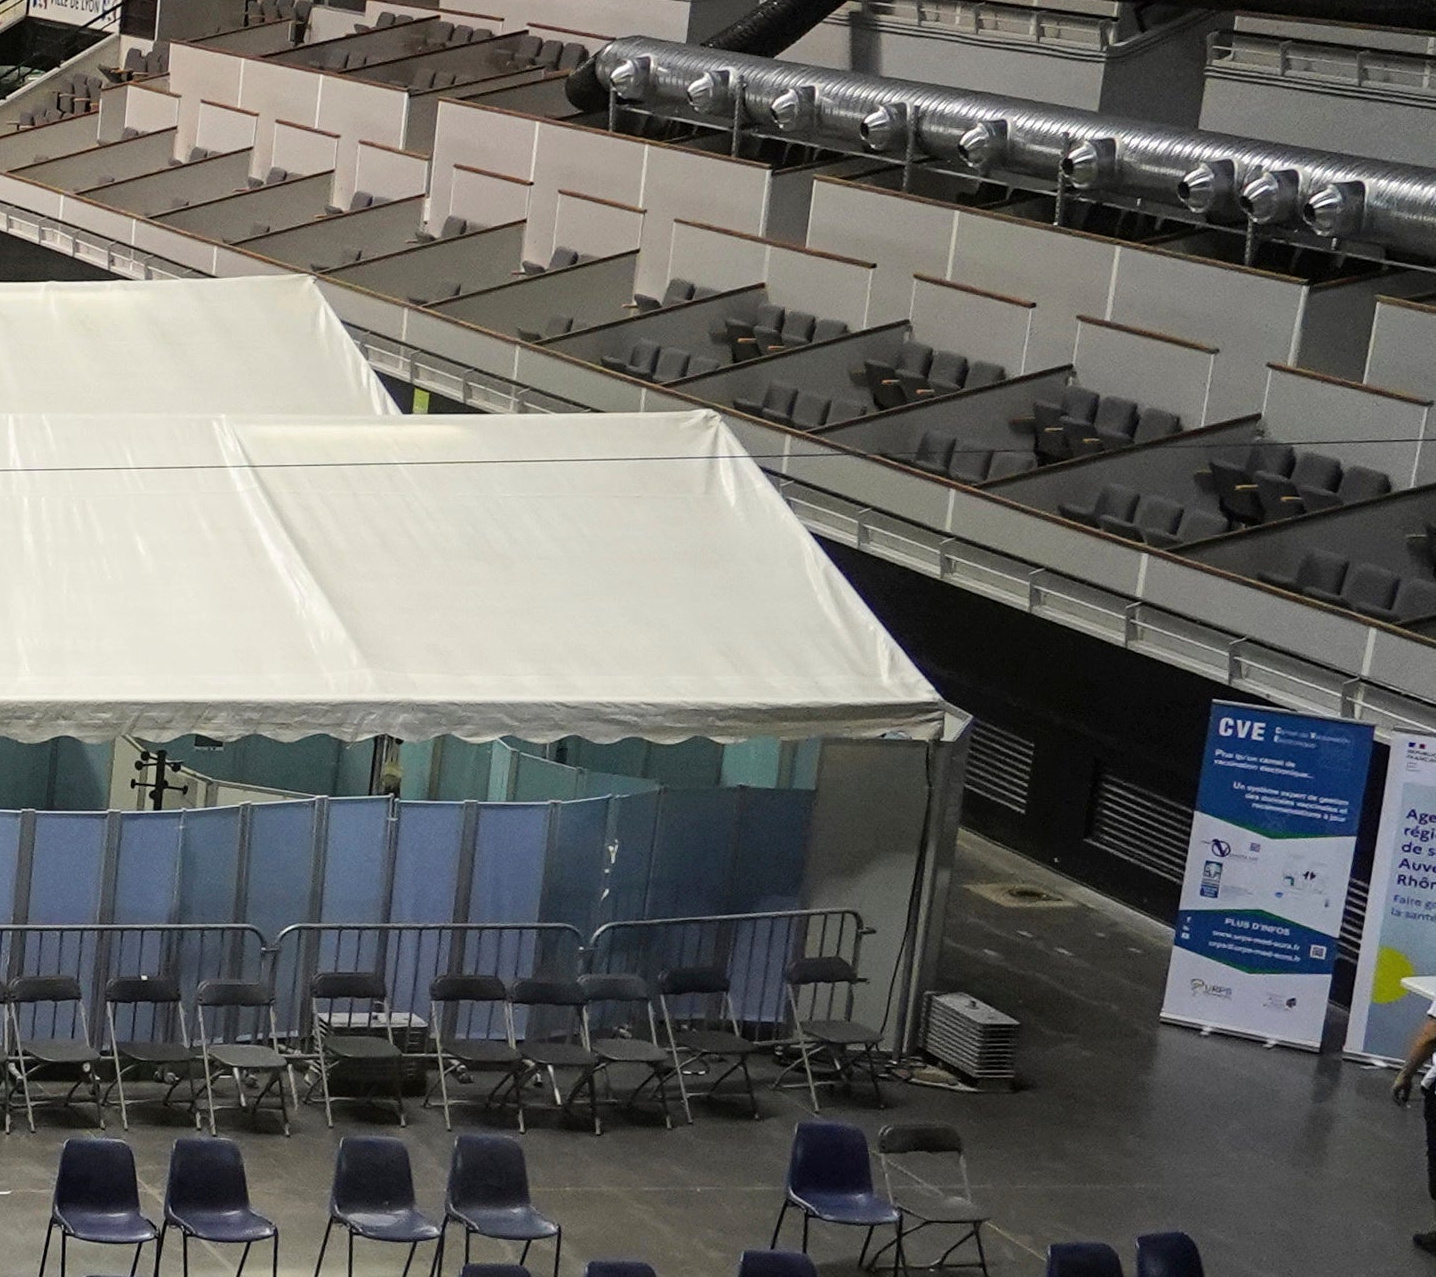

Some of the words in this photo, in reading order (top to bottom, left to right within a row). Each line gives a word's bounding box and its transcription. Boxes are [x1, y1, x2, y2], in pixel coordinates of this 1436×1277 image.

[1218, 717, 1266, 742] CVE
[1406, 808, 1436, 825] Age
[1401, 842, 1422, 855] de
[1393, 893, 1422, 907] Faire
[1391, 907, 1401, 917] la
[1225, 917, 1250, 929] PLUS
